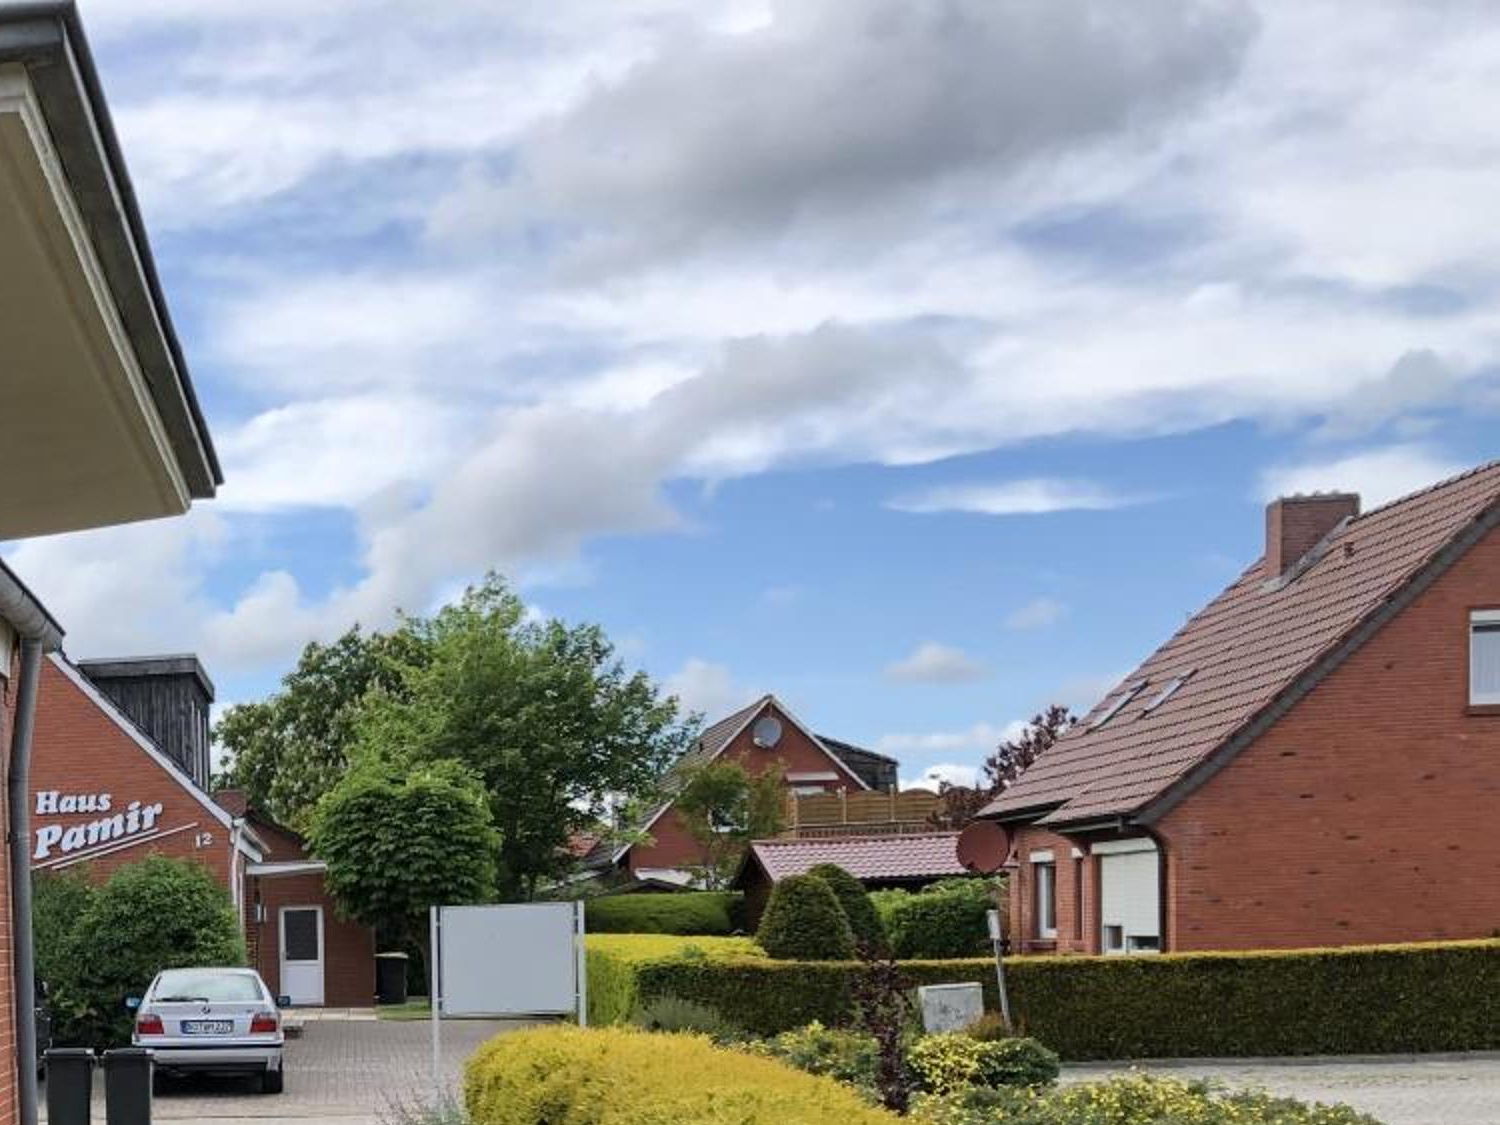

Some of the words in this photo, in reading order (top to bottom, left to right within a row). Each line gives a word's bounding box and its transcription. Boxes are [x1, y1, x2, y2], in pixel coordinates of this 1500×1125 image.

[36, 791, 112, 814] Haus
[34, 801, 163, 859] Pamir
[195, 832, 213, 848] 12
